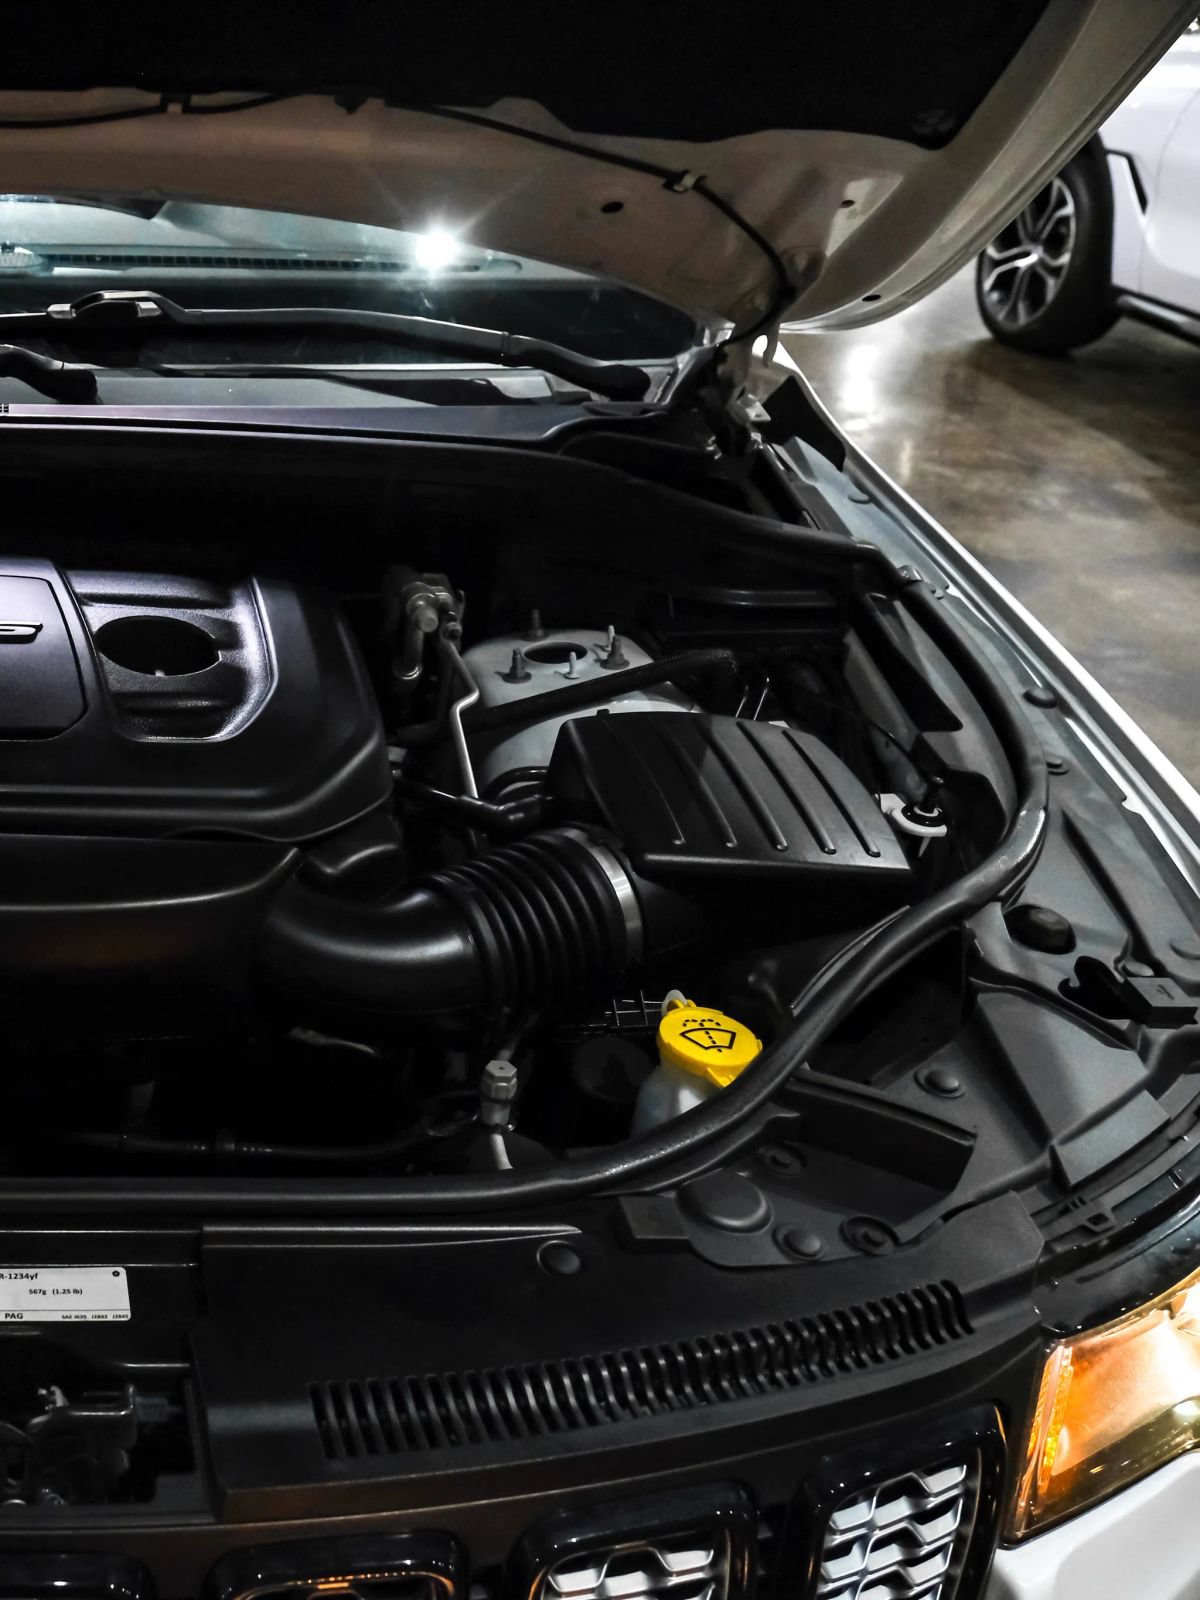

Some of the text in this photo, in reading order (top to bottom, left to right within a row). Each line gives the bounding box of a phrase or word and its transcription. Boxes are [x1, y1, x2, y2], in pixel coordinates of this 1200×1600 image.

[28, 1288, 47, 1296] 567g
[52, 1288, 72, 1296] (1.25
[4, 1312, 24, 1320] PAG
